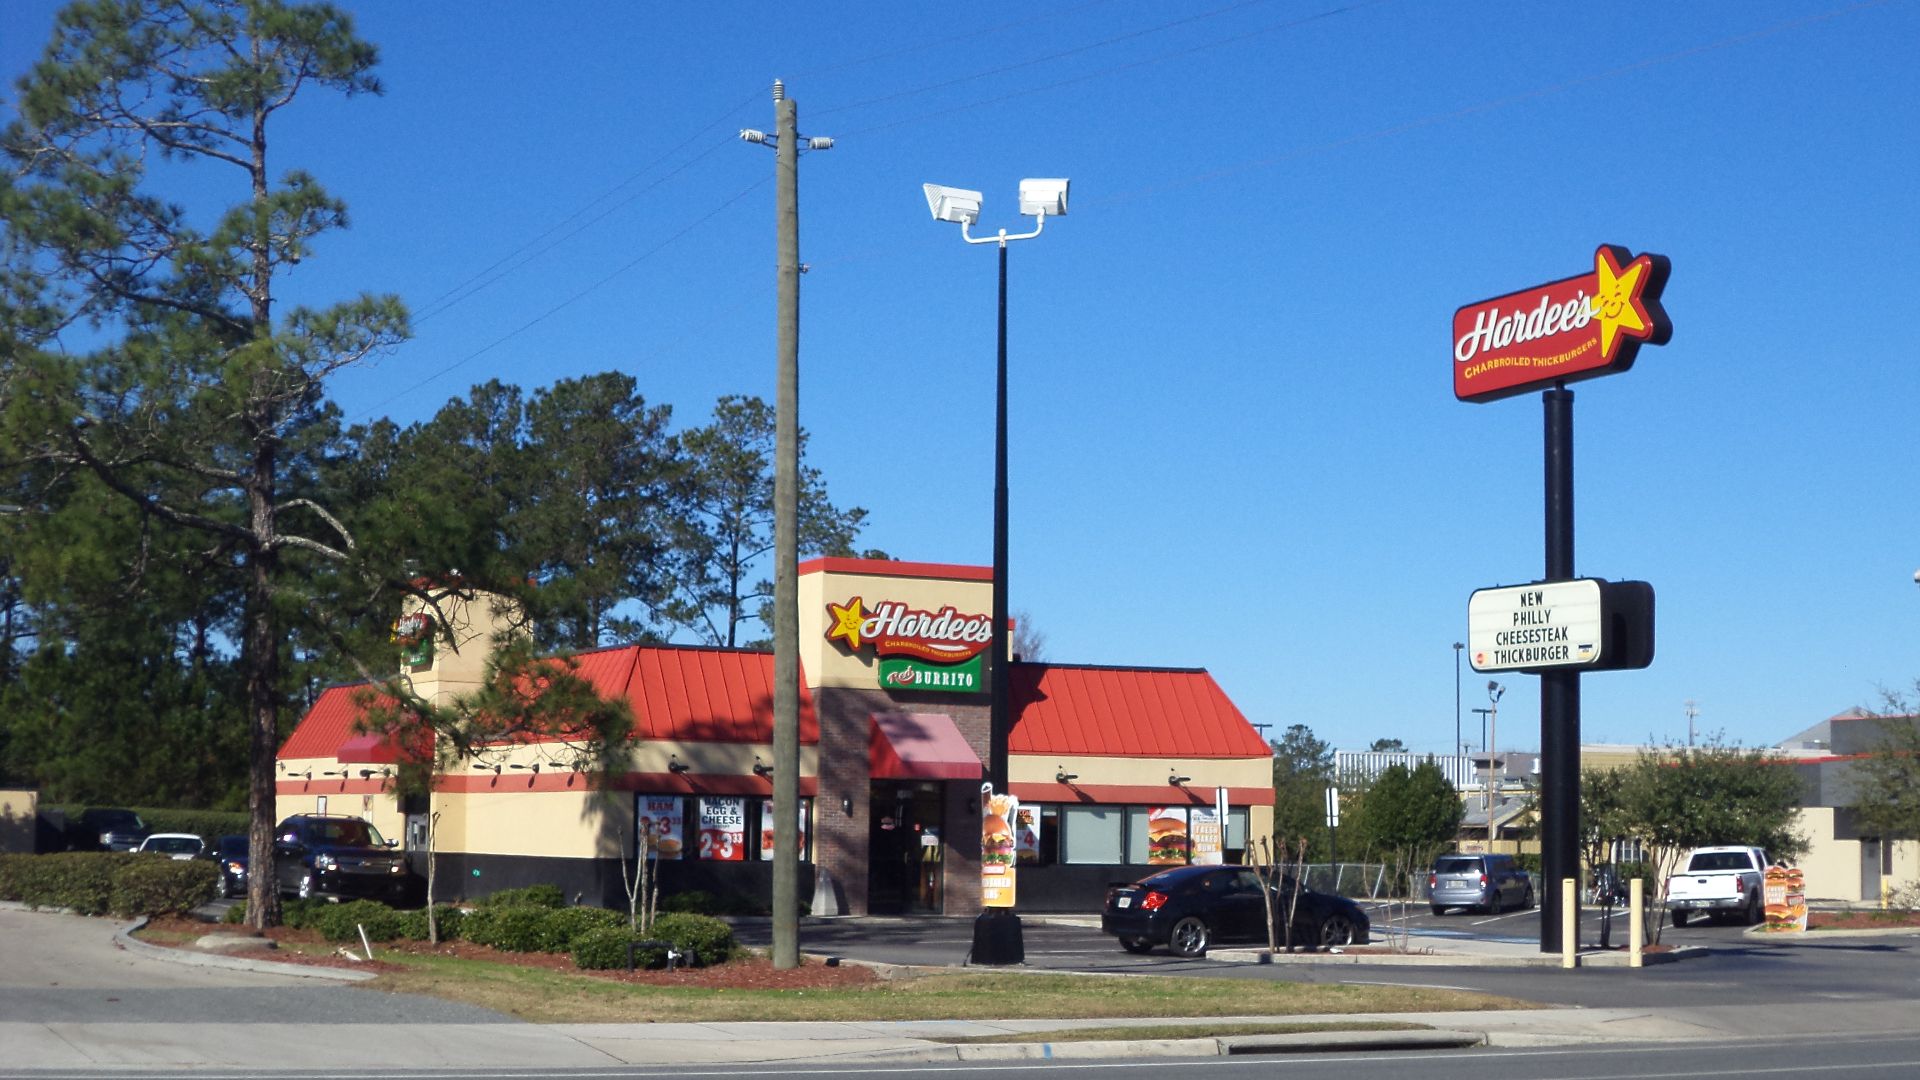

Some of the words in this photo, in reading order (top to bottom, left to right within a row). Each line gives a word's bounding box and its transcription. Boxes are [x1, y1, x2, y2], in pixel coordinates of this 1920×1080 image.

[1455, 290, 1600, 361] Hardee's
[1464, 356, 1531, 379] CHARBROILED
[1532, 337, 1598, 367] THICKBURGERS
[1520, 591, 1544, 608] NEW
[860, 602, 993, 643] Hardee's
[1513, 609, 1552, 627] PHILLY
[1495, 626, 1569, 647] CHEESESTEAK
[884, 641, 930, 653] CHARBROILED
[1494, 645, 1570, 665] THICKBURGER
[887, 665, 915, 685] Red
[915, 670, 973, 687] BURRITO
[701, 815, 742, 825] CHEESE
[706, 806, 727, 815] EGG
